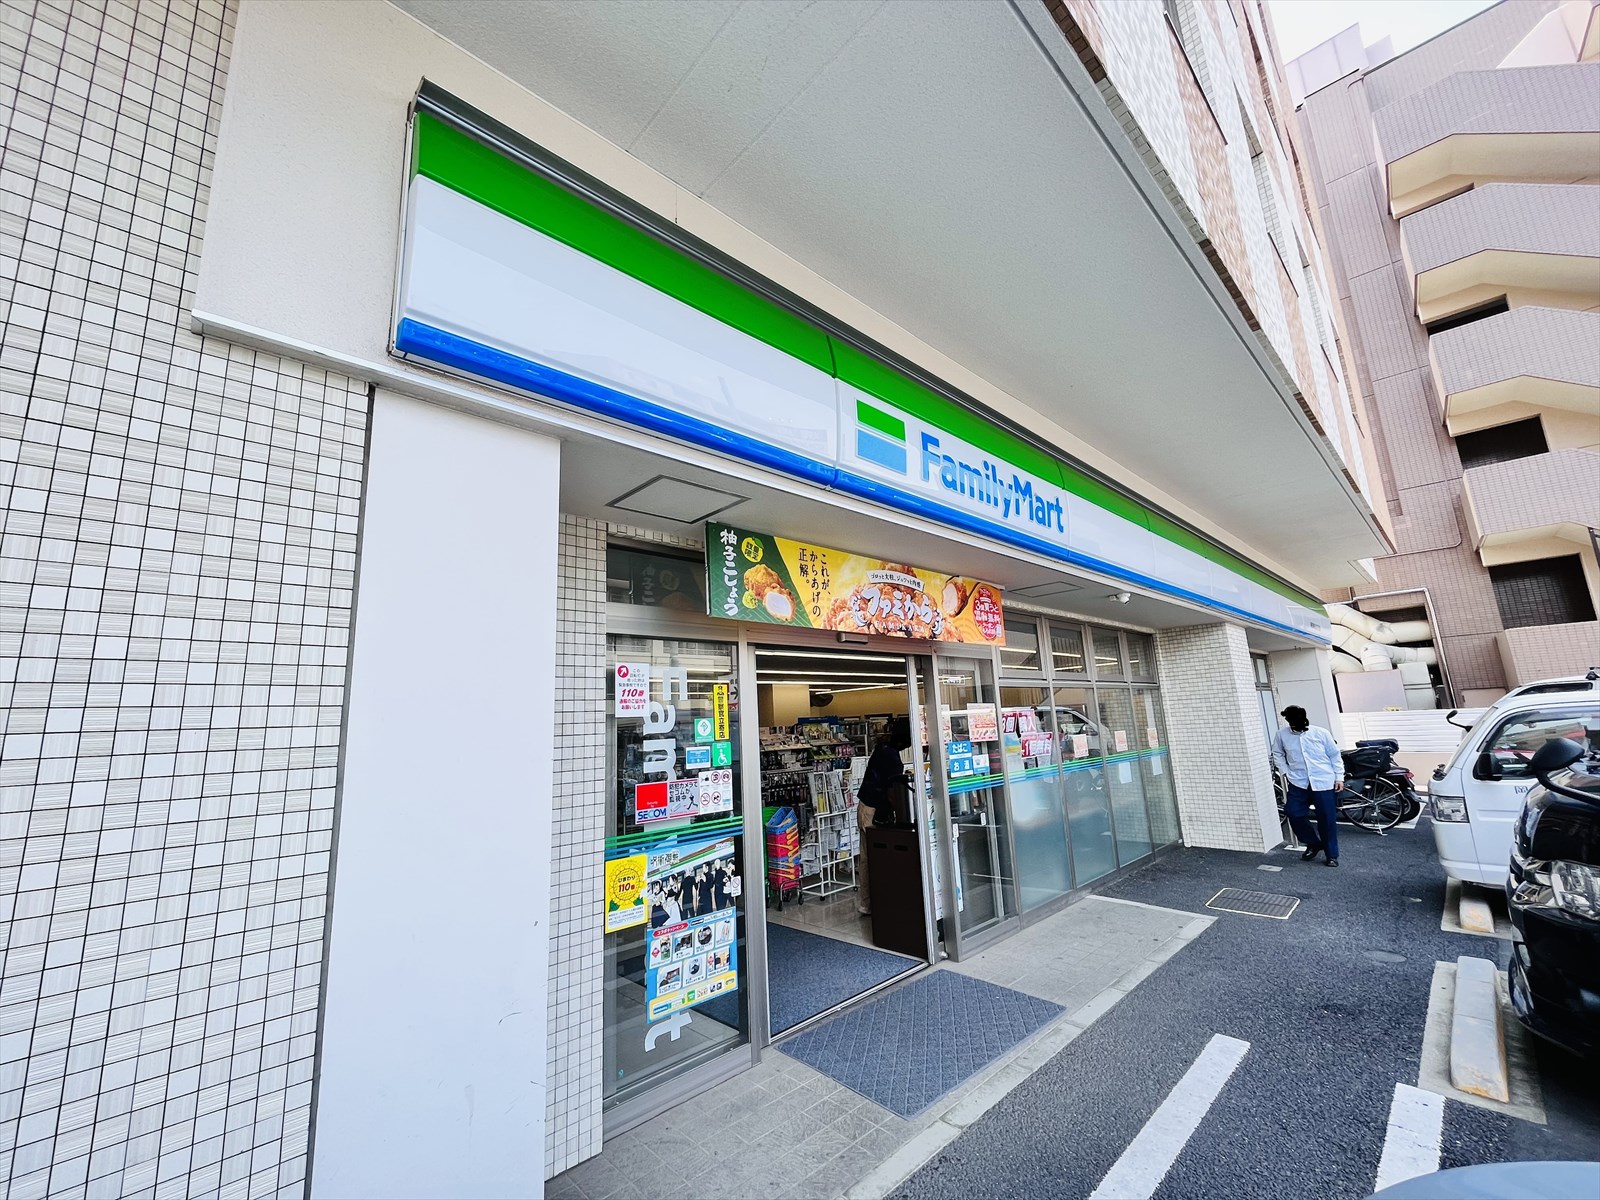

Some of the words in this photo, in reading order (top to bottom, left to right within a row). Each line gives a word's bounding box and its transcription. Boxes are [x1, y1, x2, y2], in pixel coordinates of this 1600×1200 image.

[921, 431, 1065, 534] FamilyMart
[798, 547, 810, 584] 正解。
[720, 528, 739, 617] 柚子こしょう
[820, 553, 832, 595] これが、
[809, 550, 821, 617] からあげの
[861, 587, 933, 624] ファミから
[621, 689, 645, 697] 110番
[952, 743, 968, 753] たばこ
[669, 781, 698, 790] 防犯カメラで
[638, 808, 667, 820] SECOM
[617, 875, 636, 883] ひまわり
[618, 883, 636, 893] 110番
[656, 925, 685, 936] コラボキャンペーン
